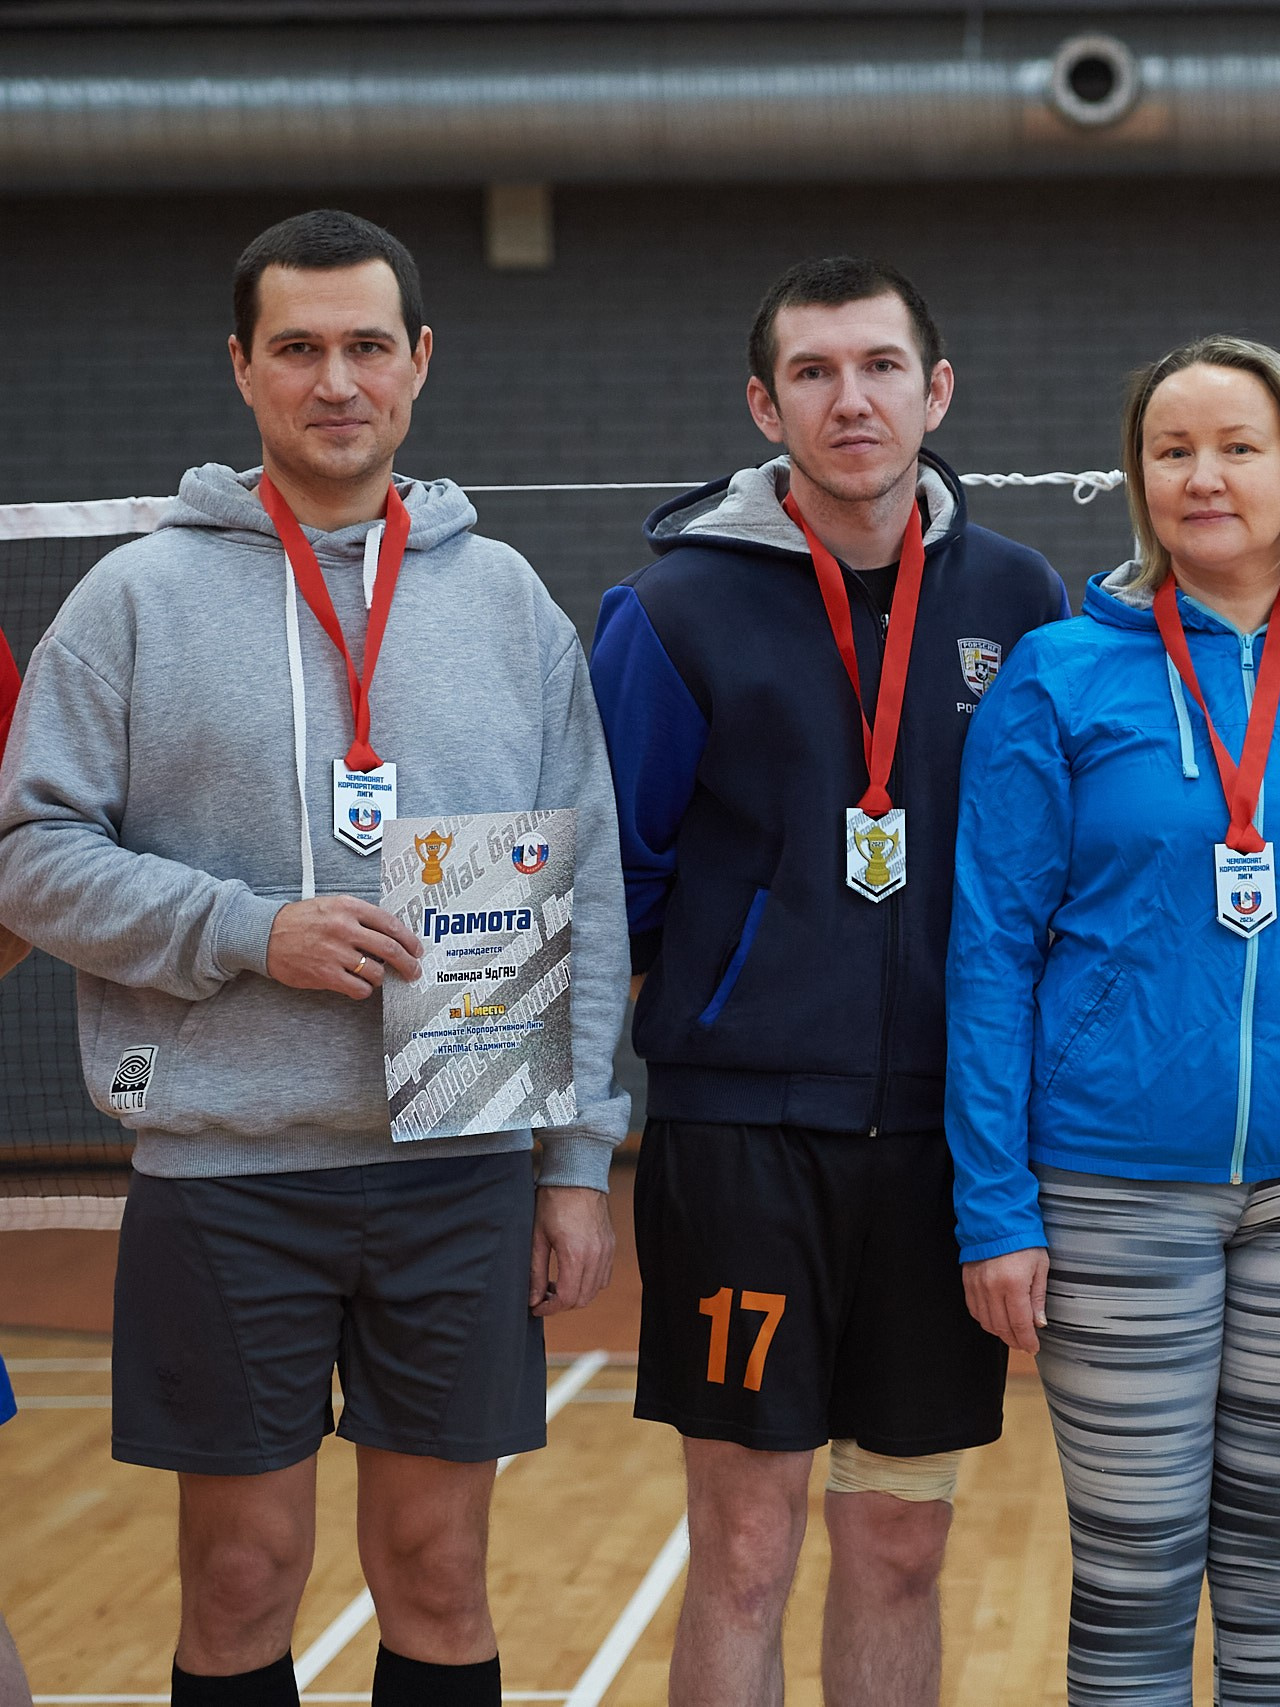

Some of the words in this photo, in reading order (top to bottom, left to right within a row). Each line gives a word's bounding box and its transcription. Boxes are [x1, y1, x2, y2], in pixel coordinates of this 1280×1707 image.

[963, 642, 997, 652] PORSCHE
[345, 774, 384, 783] ЧЕМПИОНАТ
[337, 781, 393, 792] КОРПОРАТИВНОЙ
[356, 790, 374, 798] ЛИГИ
[1226, 857, 1262, 865] ЧЕМПИОНАТ
[1219, 864, 1270, 873] КОРПОРАТИВНОЙ
[423, 908, 531, 943] Грамота
[446, 946, 503, 957] награждается
[436, 971, 483, 983] Команда
[485, 965, 516, 980] УдГАУ
[450, 1008, 462, 1019] за
[463, 992, 471, 1018] 1
[473, 1003, 506, 1017] место
[419, 1028, 465, 1039] чемпионате
[466, 1020, 525, 1036] Корпоративной
[526, 1019, 544, 1029] Лиги
[699, 1286, 787, 1392] 17
